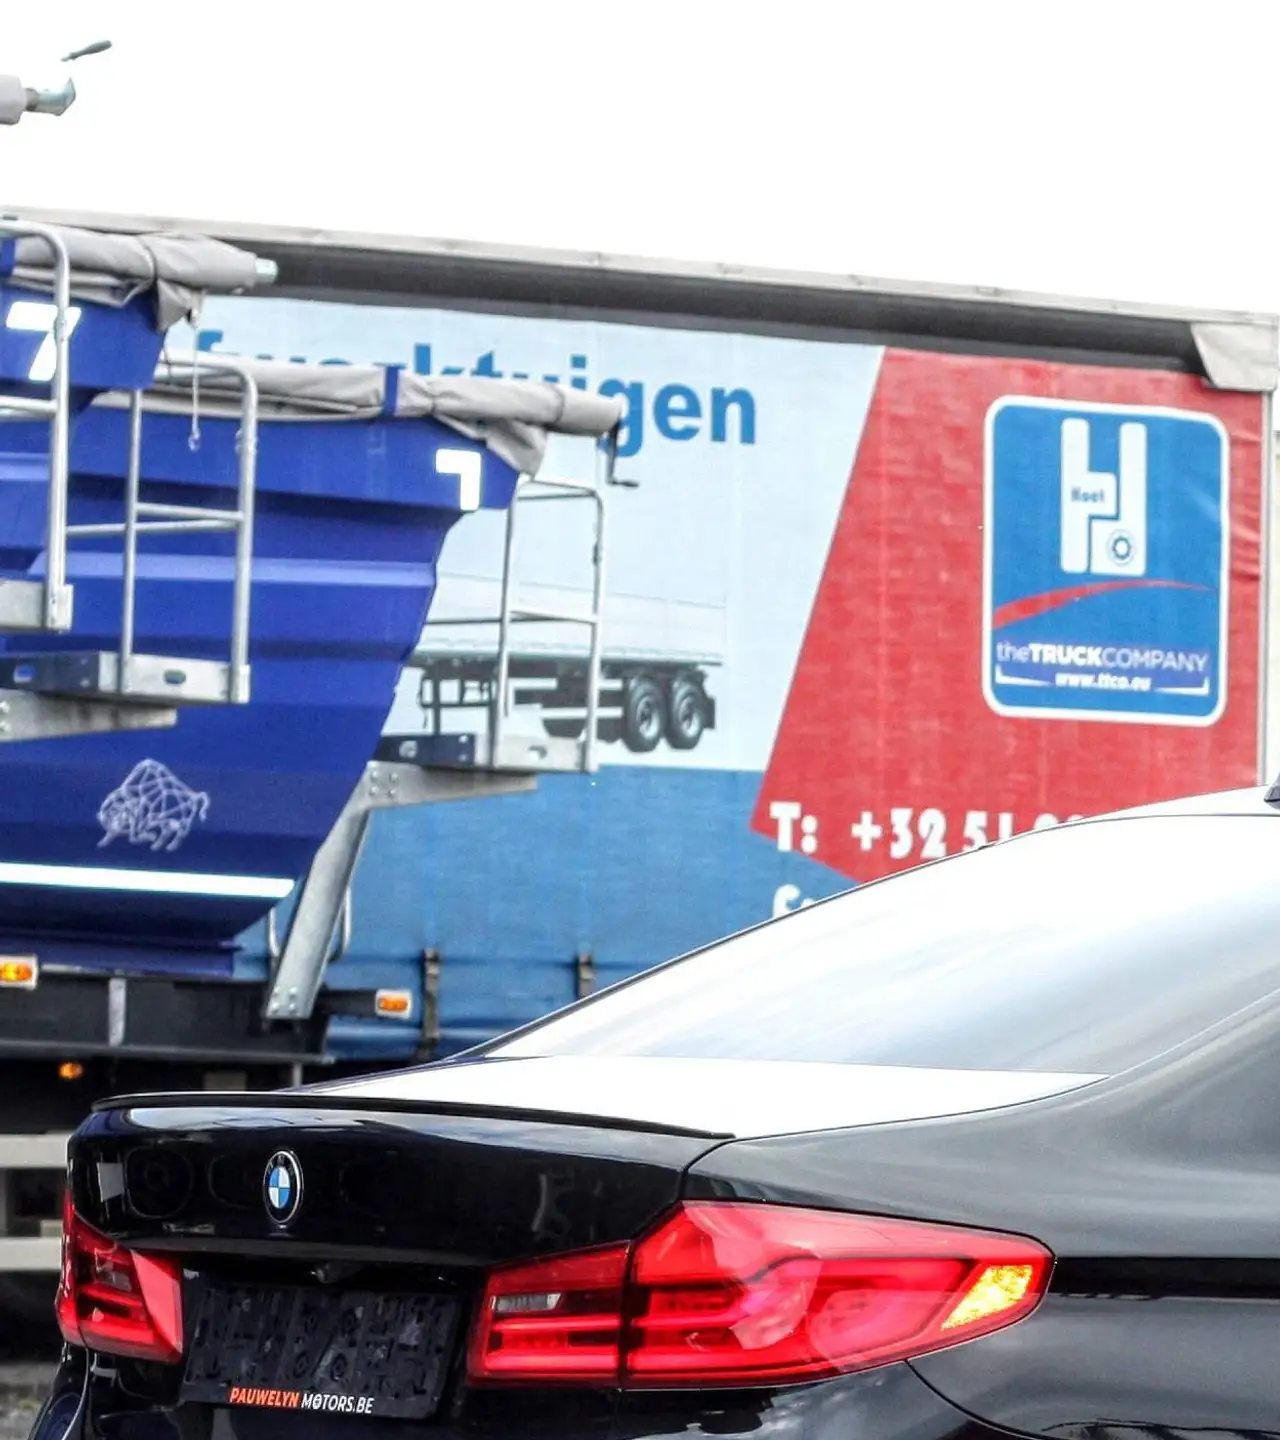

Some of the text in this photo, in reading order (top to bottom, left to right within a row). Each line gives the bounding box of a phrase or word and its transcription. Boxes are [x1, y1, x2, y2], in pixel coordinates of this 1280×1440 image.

[996, 641, 1209, 672] theTRUCKCOMPANY
[769, 801, 818, 854] T:
[851, 807, 948, 858] +32
[229, 1387, 375, 1414] PAUWELYN MOTORS.BE
